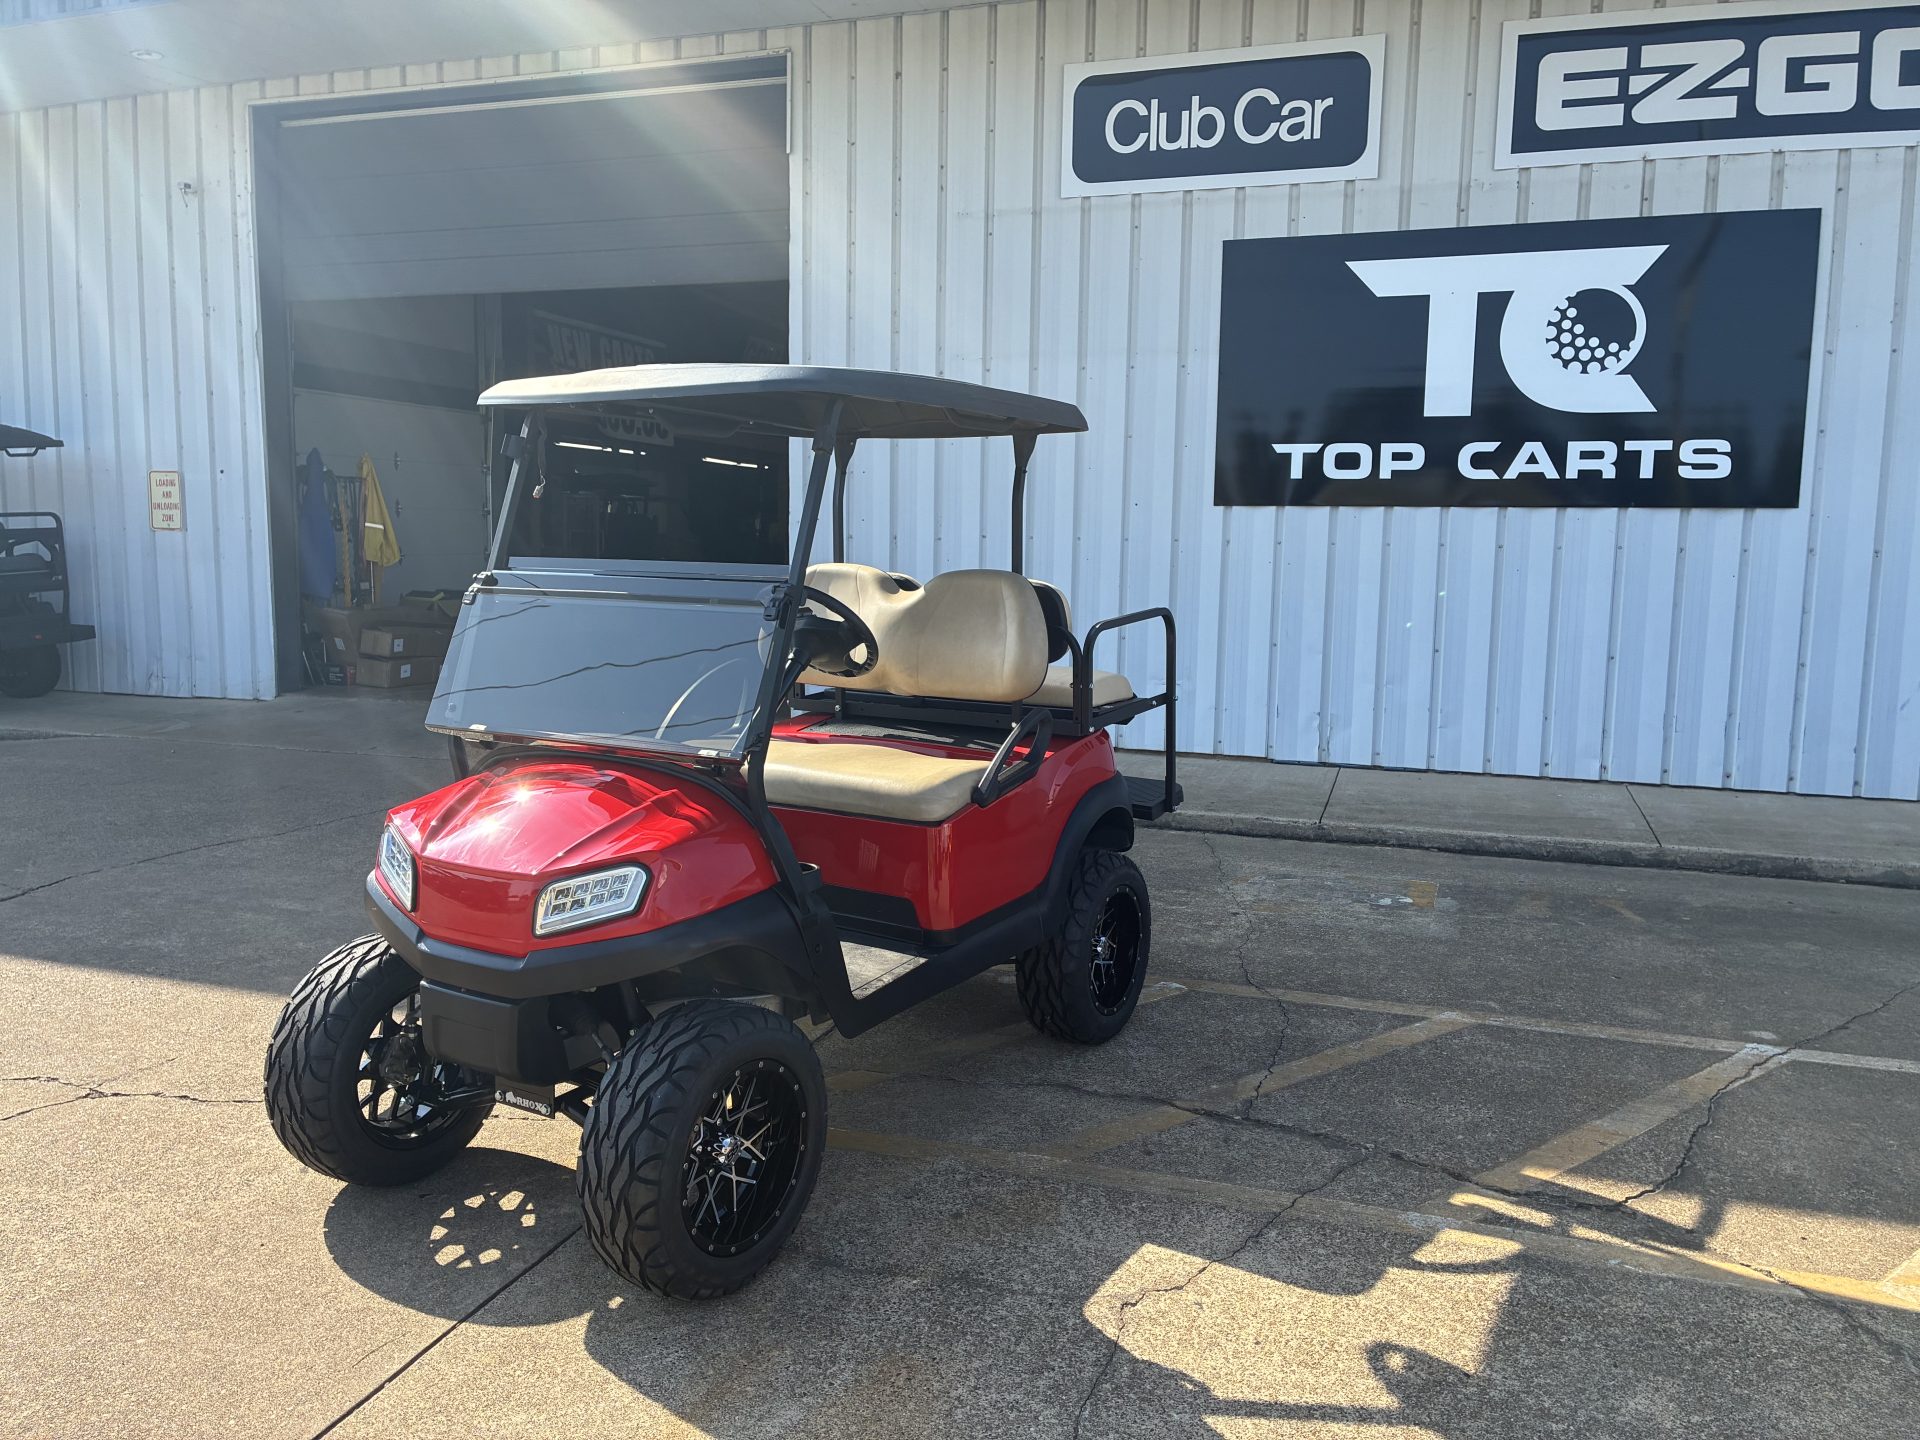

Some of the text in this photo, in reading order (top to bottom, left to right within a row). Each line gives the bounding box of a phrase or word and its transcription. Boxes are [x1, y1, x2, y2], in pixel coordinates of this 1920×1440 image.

[1104, 87, 1334, 154] Club Car
[1271, 439, 1733, 480] TOP CARTS
[155, 478, 177, 487] LOADING
[162, 490, 173, 499] AND
[152, 501, 180, 511] UNLOADING
[161, 513, 174, 522] ZONE
[516, 1096, 542, 1112] RHOX
